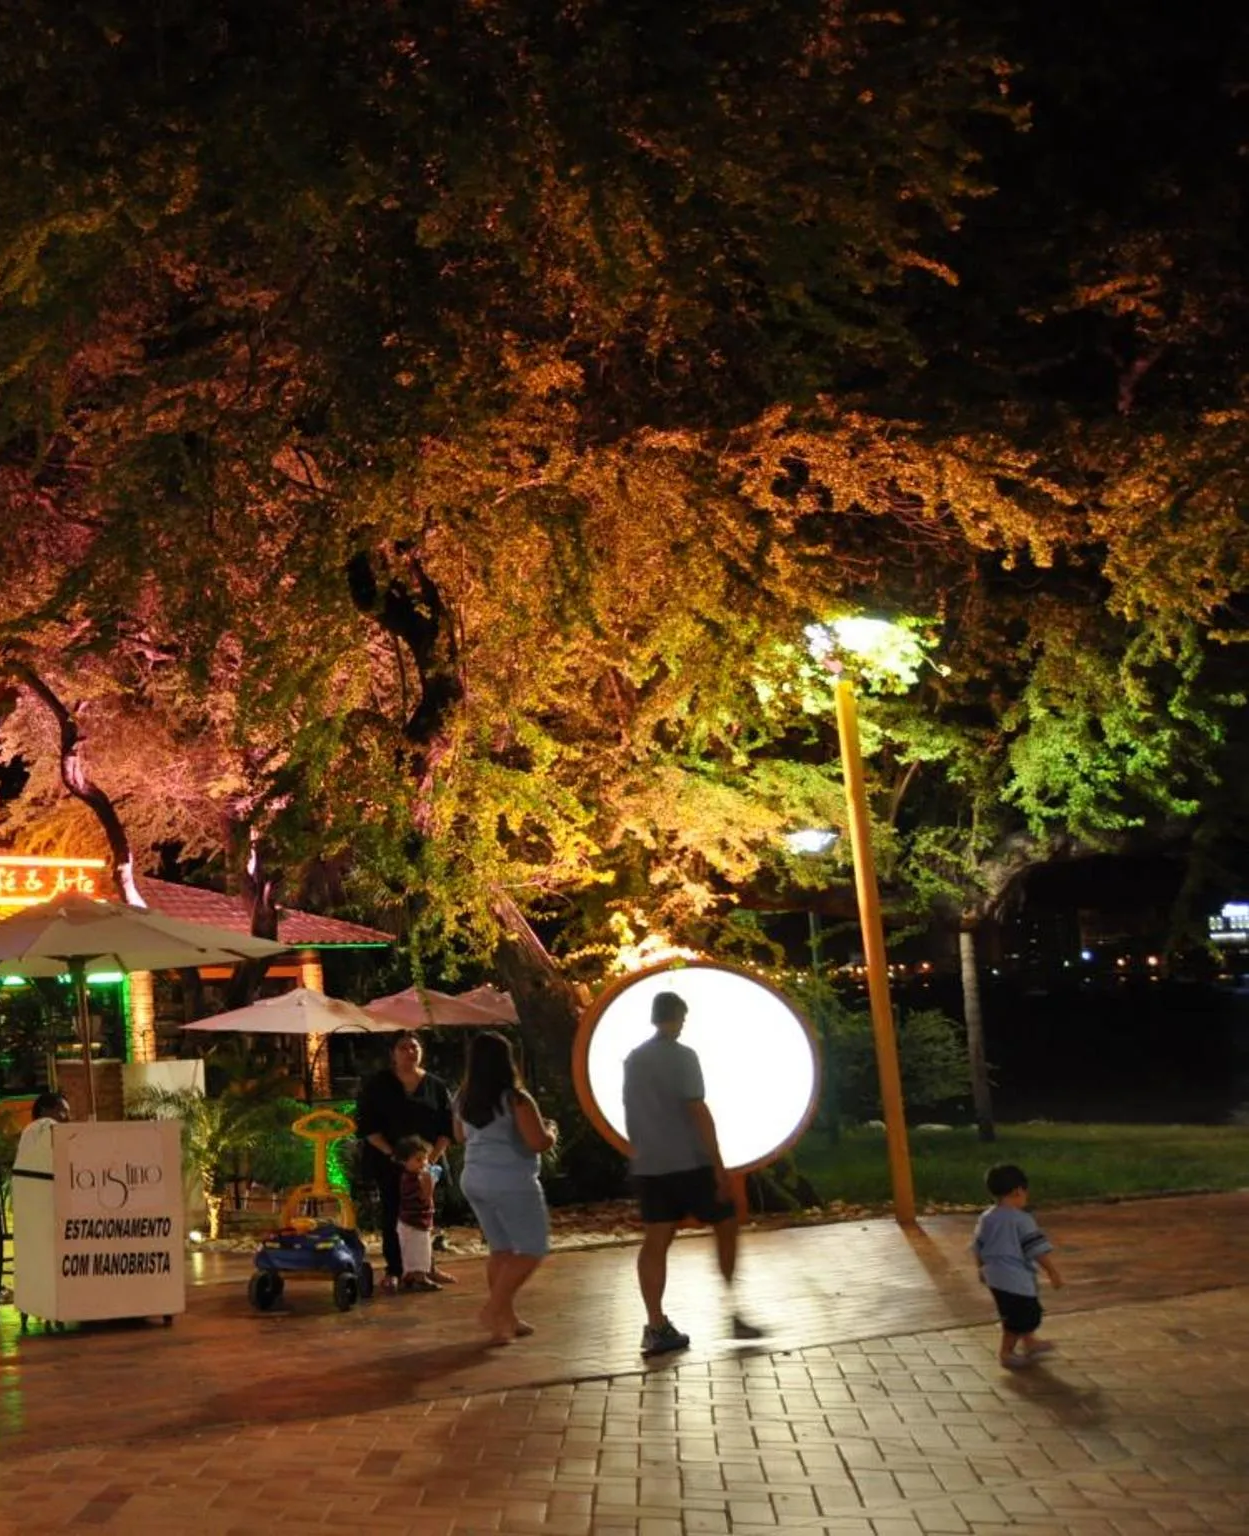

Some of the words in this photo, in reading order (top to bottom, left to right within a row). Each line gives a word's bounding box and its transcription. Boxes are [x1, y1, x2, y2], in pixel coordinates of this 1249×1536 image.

[25, 868, 44, 892] &
[54, 867, 95, 894] Arte
[64, 1216, 172, 1241] ESTACIONAMENTO
[62, 1253, 89, 1277] COM
[93, 1251, 171, 1275] MANOBRISTA
